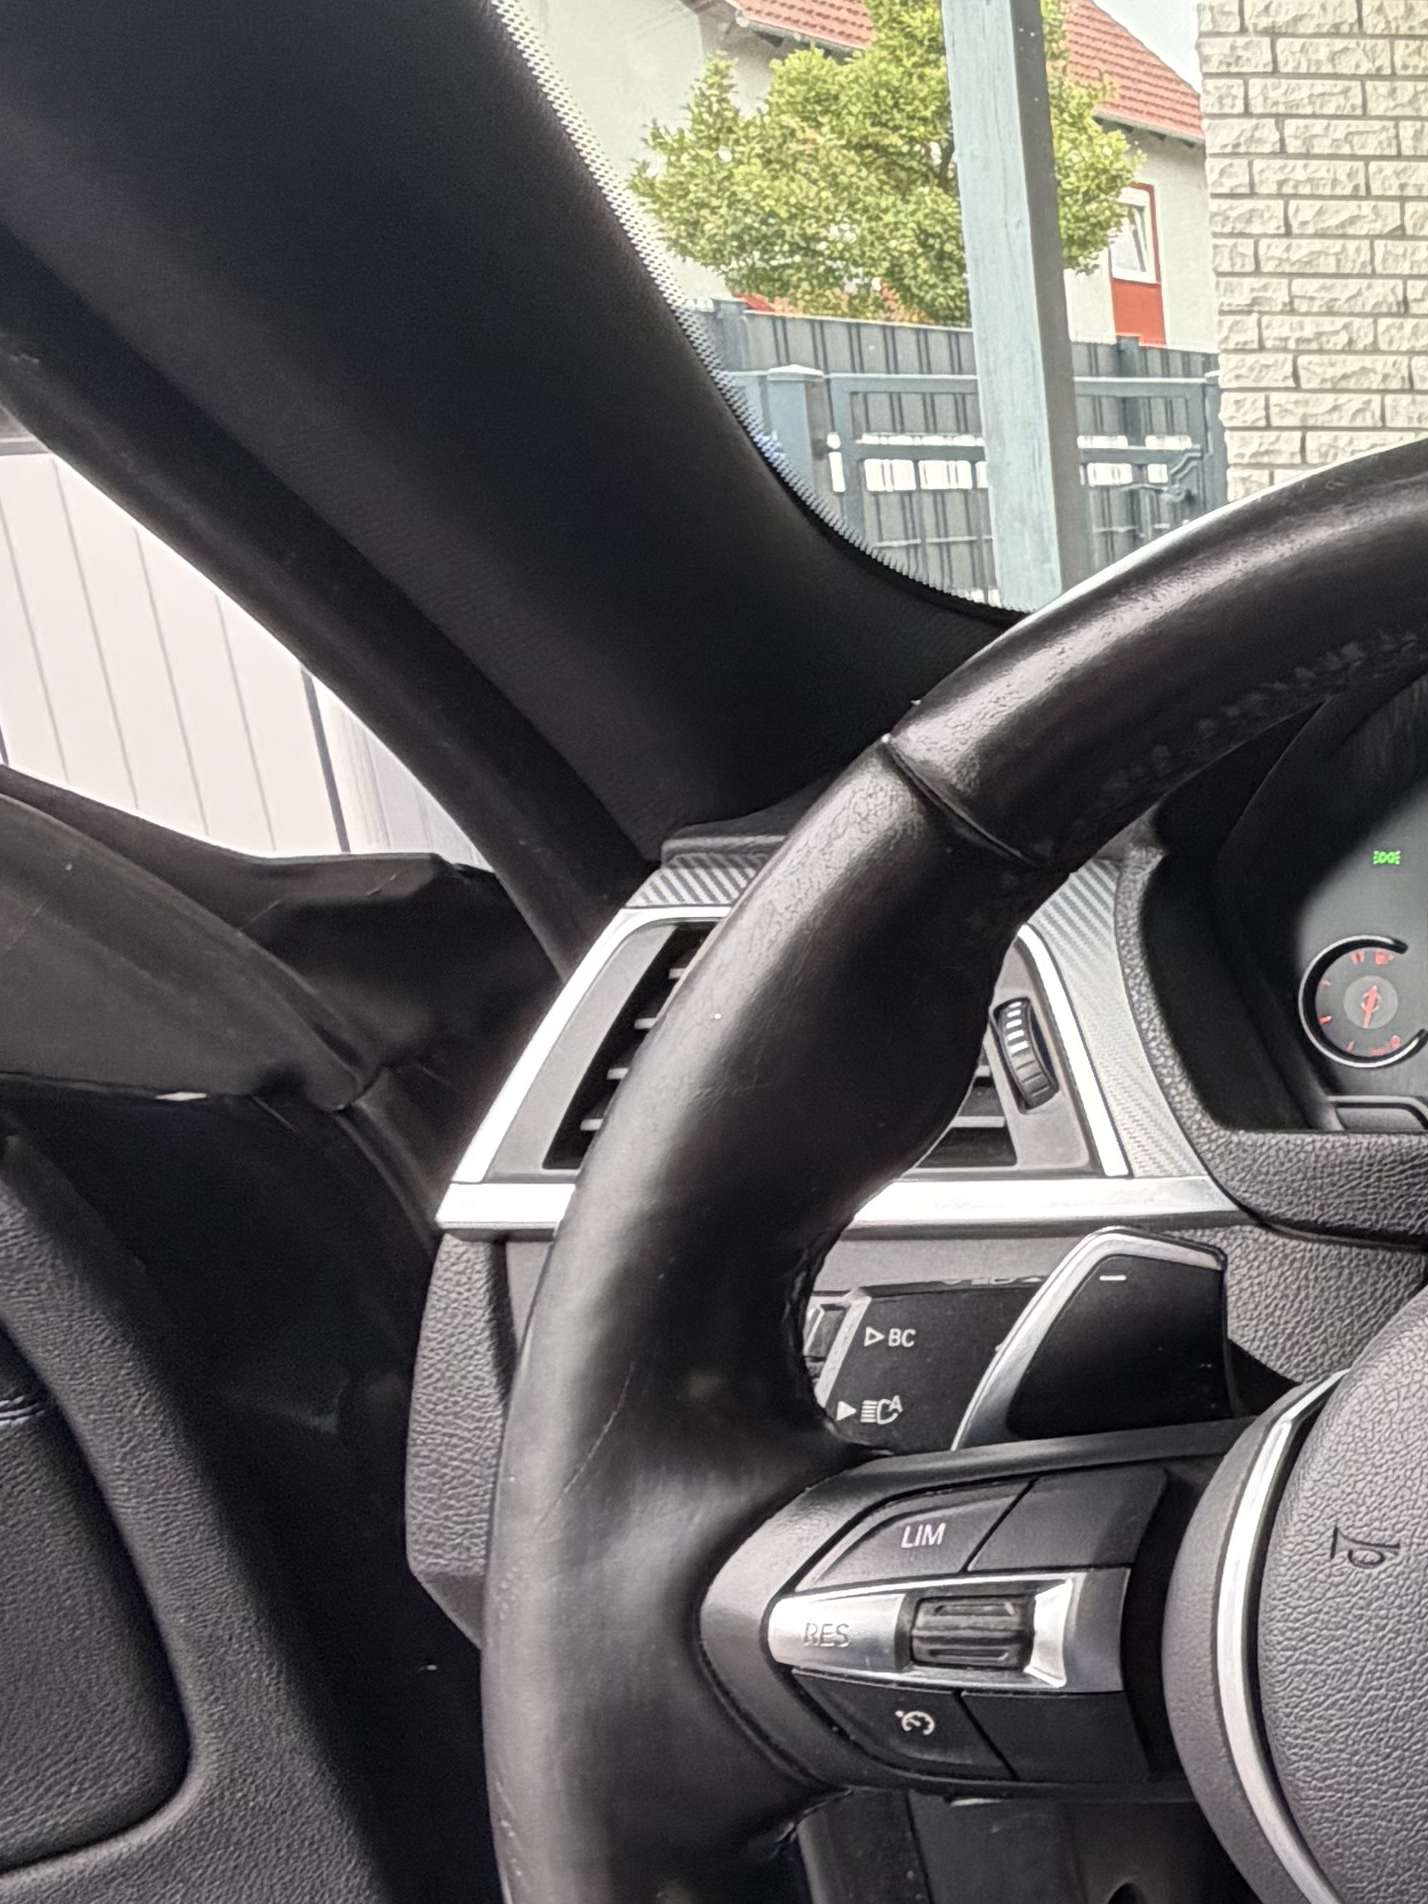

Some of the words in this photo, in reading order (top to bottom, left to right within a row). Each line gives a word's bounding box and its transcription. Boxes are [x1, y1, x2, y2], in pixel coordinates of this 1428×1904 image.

[887, 1327, 917, 1349] BC
[901, 1523, 946, 1549] LIM
[803, 1622, 850, 1648] RES
